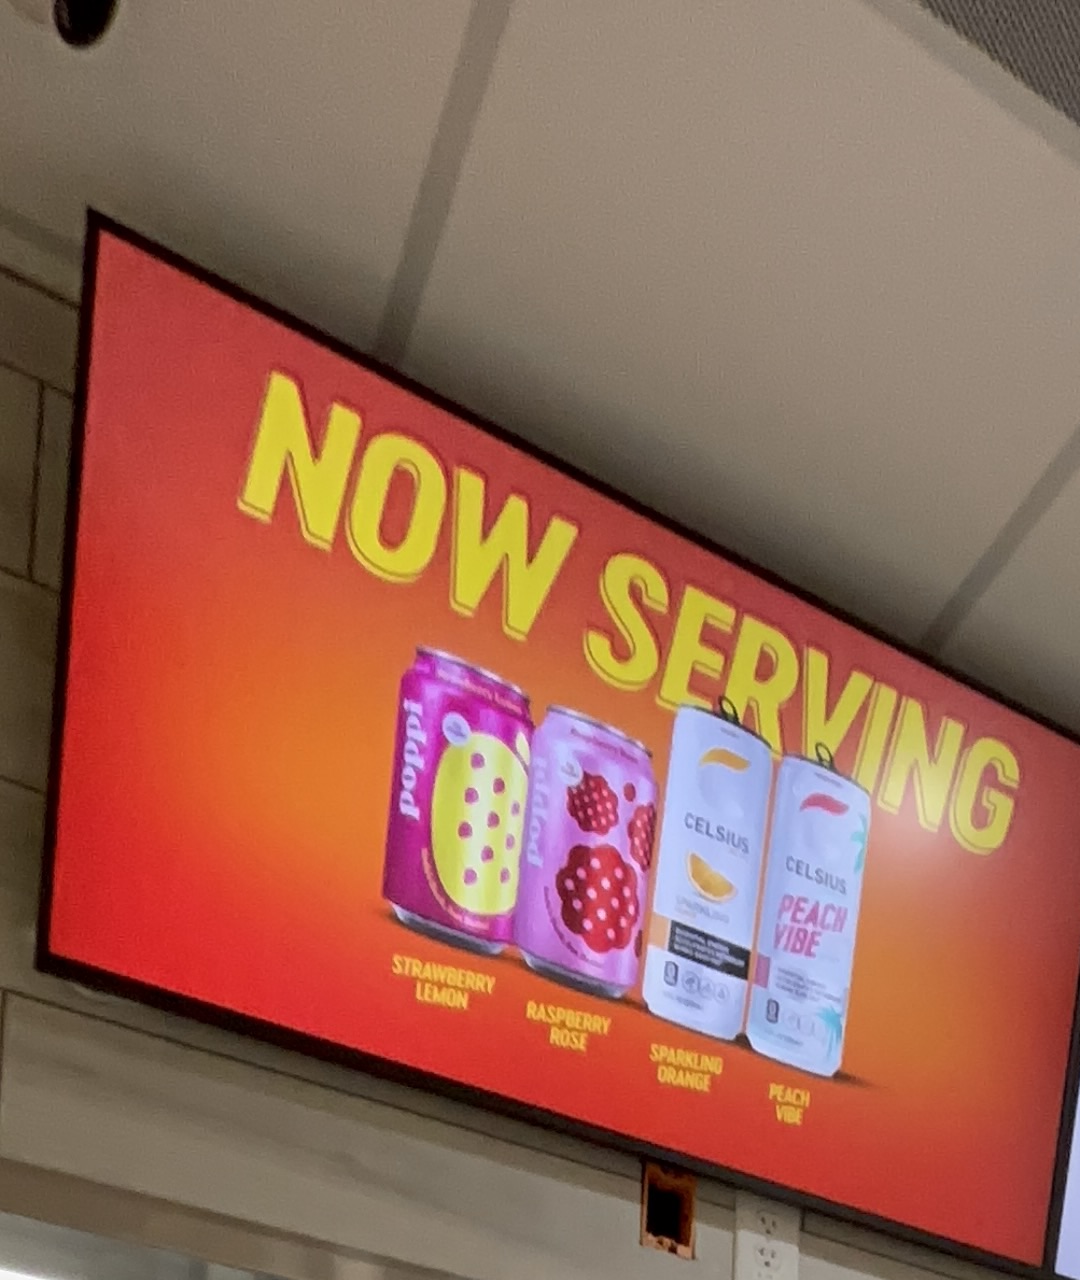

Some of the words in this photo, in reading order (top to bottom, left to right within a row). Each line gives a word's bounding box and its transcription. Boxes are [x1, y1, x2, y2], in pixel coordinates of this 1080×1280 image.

[237, 369, 580, 642] NOW
[583, 551, 1022, 857] SERVING
[399, 697, 427, 821] poppi
[684, 812, 750, 855] CELSIUS
[785, 855, 848, 896] CELSIUS
[776, 893, 849, 934] PEACH
[773, 923, 823, 959] VIBE
[391, 953, 497, 995] STRAWBERRY
[415, 981, 469, 1010] LEMON
[525, 999, 612, 1036] RASPBERRY
[549, 1026, 589, 1052] ROSE
[648, 1042, 724, 1076] SPARKLING
[657, 1065, 712, 1093] ORANGE
[768, 1082, 811, 1108] PEACH
[775, 1103, 804, 1126] VIBE
